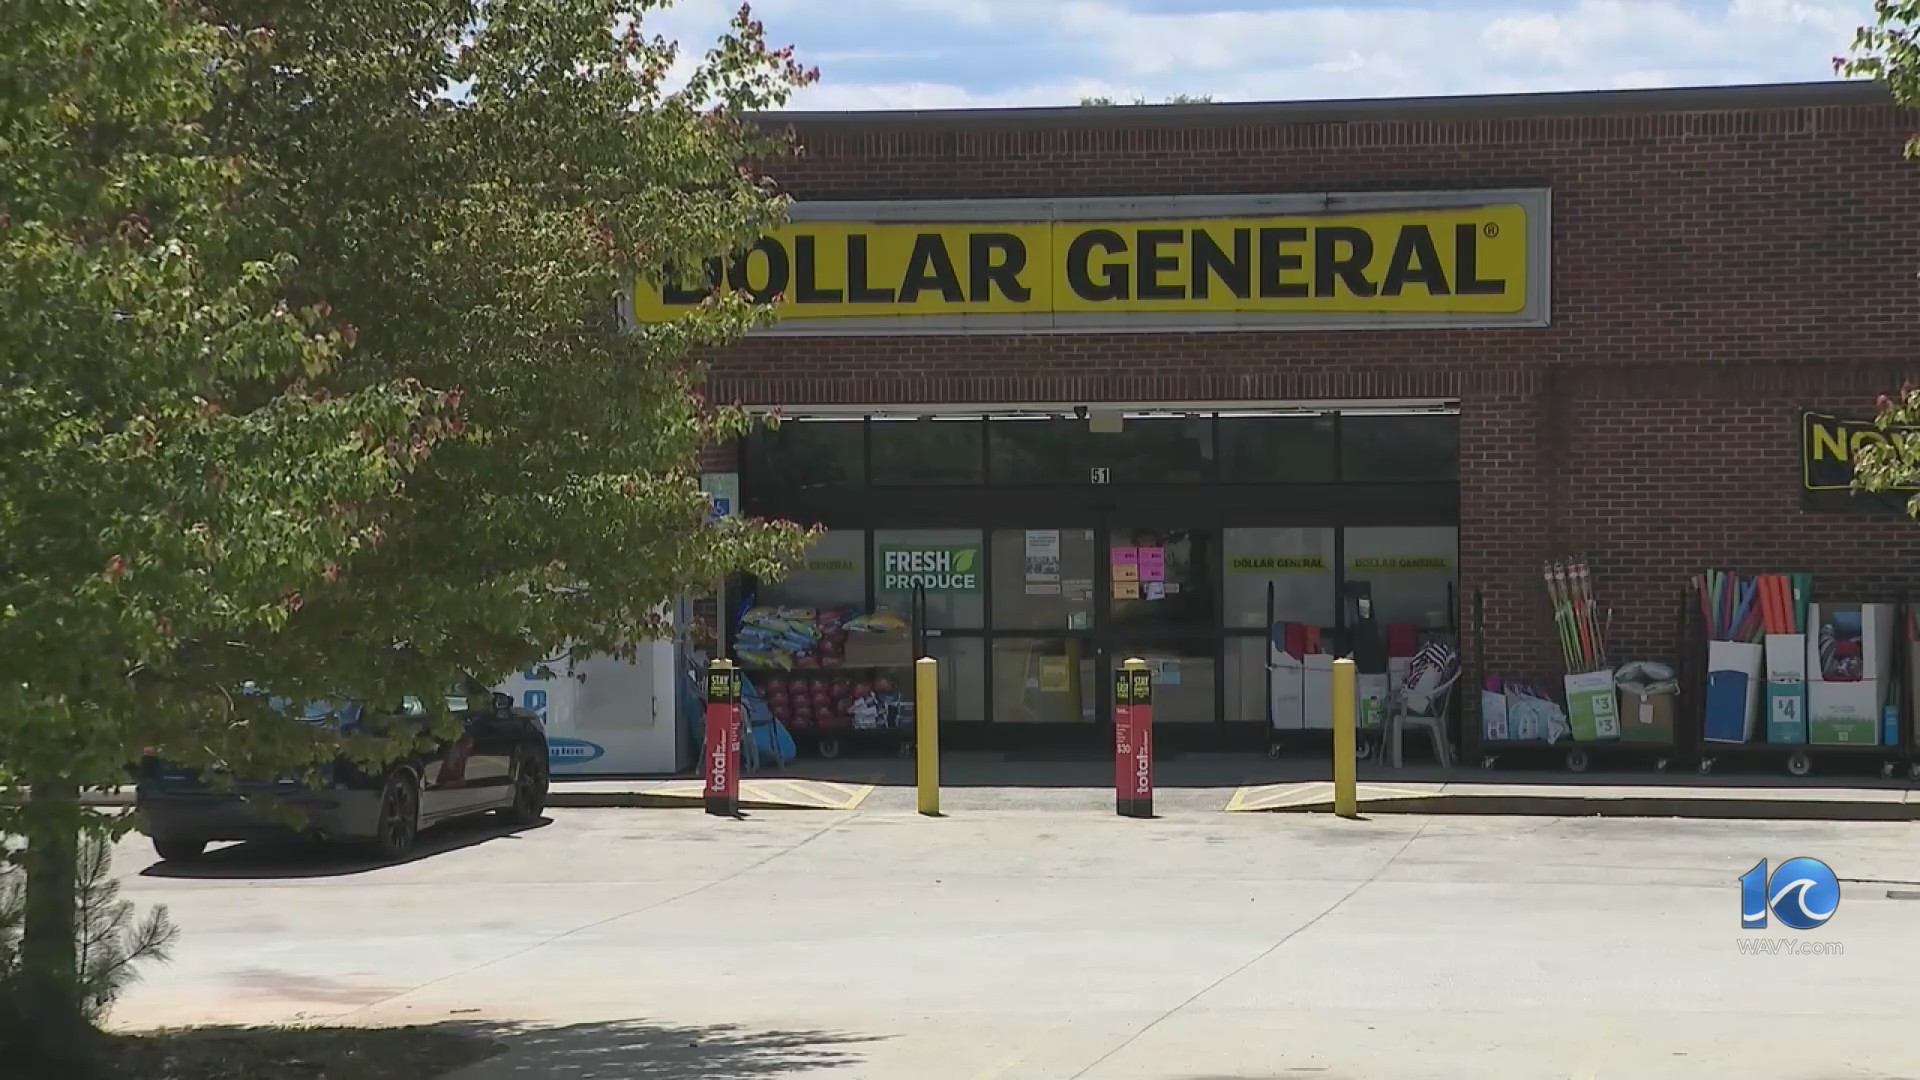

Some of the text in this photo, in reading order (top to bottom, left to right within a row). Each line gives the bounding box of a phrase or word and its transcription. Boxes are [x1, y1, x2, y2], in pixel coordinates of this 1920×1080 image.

[1092, 468, 1108, 483] 51
[884, 551, 950, 572] FRESH
[1233, 558, 1325, 569] DOLLAR GENERAL
[885, 574, 976, 589] PRODUCE
[1778, 699, 1796, 720] $4
[711, 752, 726, 792] total
[1137, 755, 1148, 794] total
